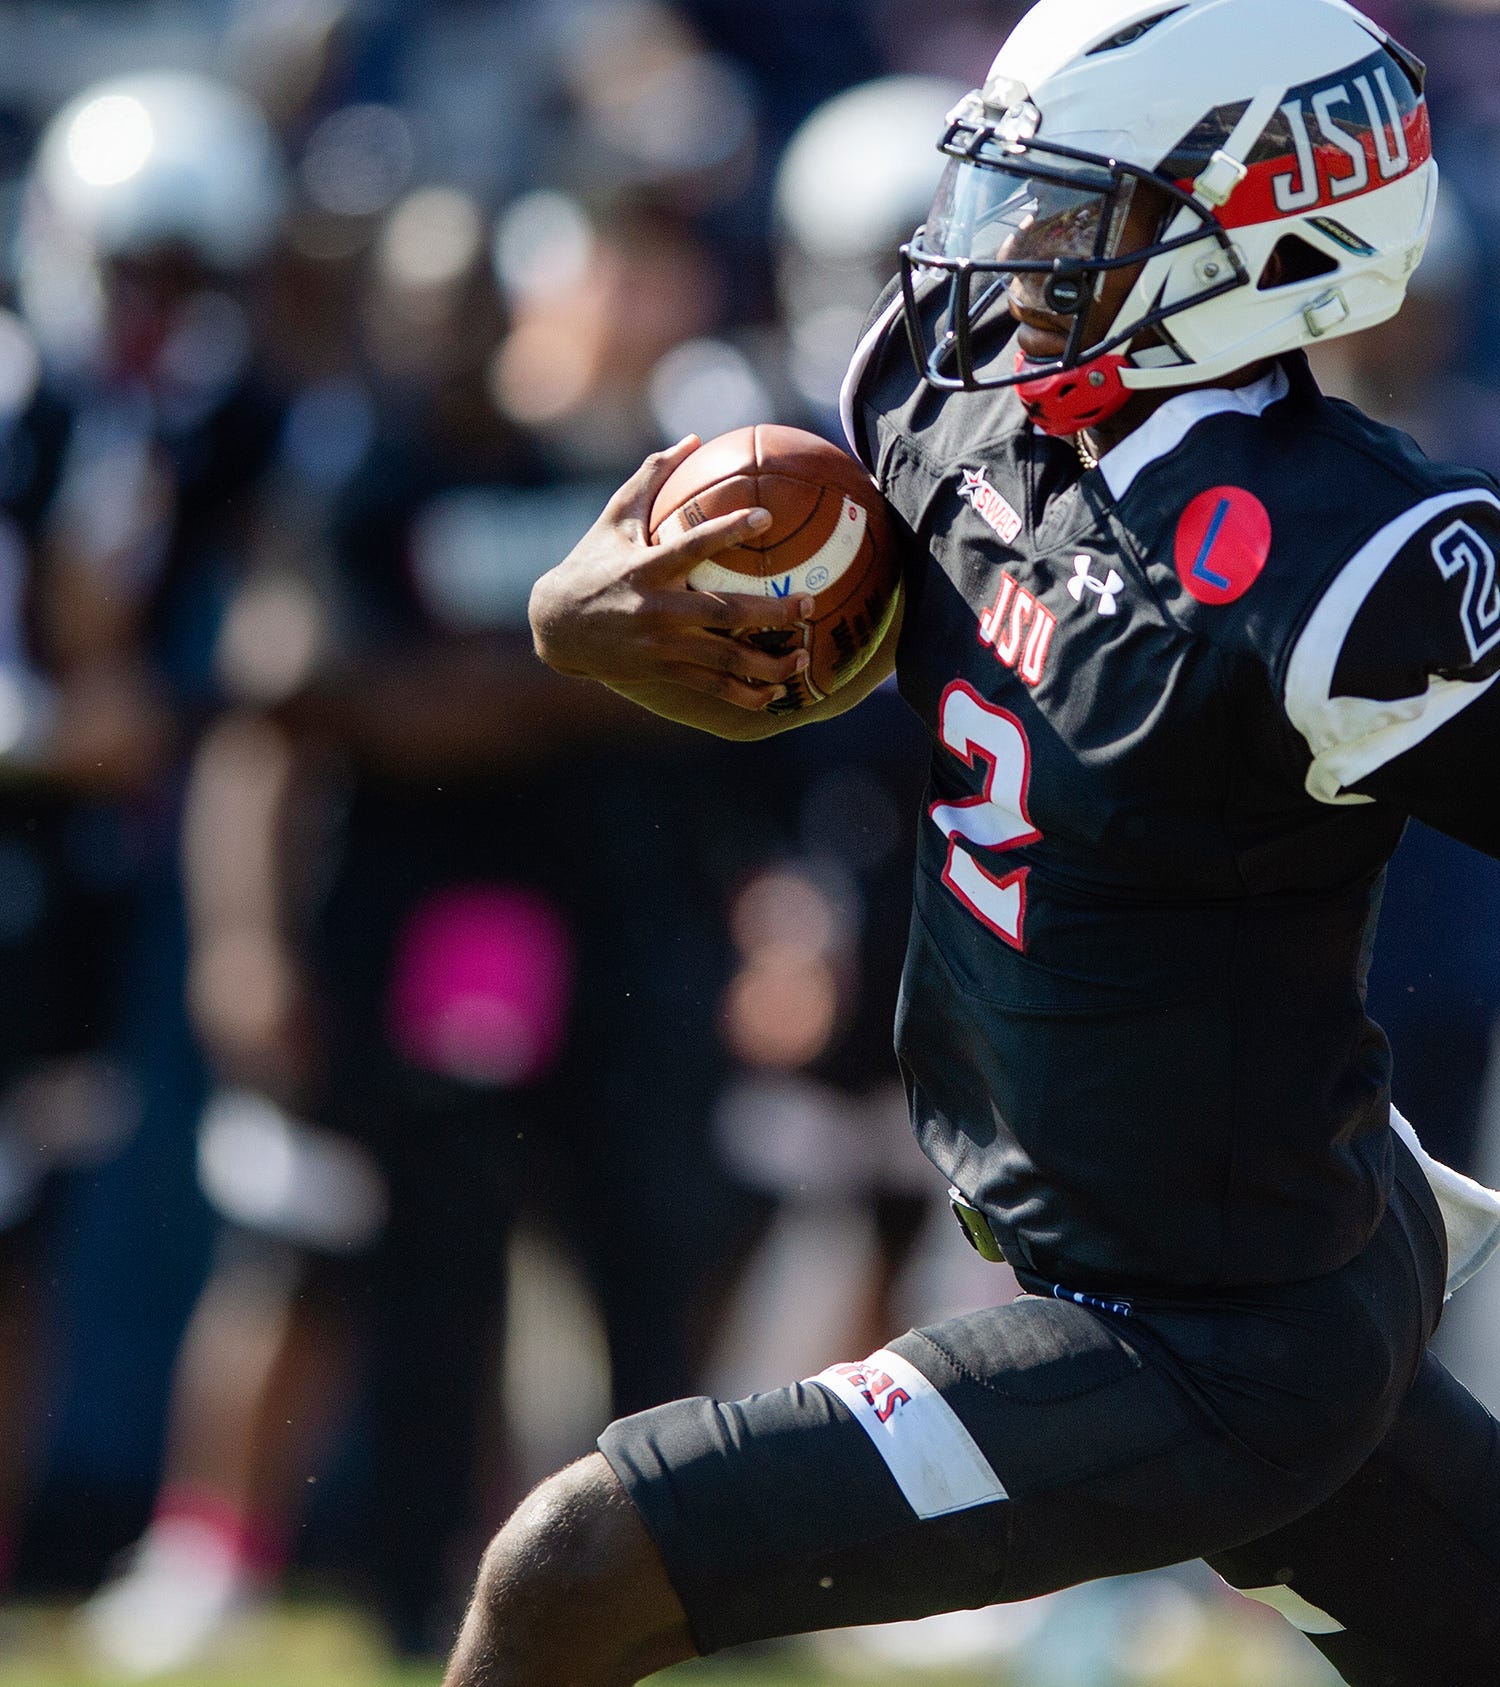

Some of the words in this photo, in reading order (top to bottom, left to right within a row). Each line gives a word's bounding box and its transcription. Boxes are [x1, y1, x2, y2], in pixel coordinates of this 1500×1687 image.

[1272, 66, 1410, 213] JSU
[976, 487, 1018, 540] SWAC
[1192, 499, 1231, 590] L
[976, 569, 1058, 687] JSU
[928, 678, 1044, 954] 2
